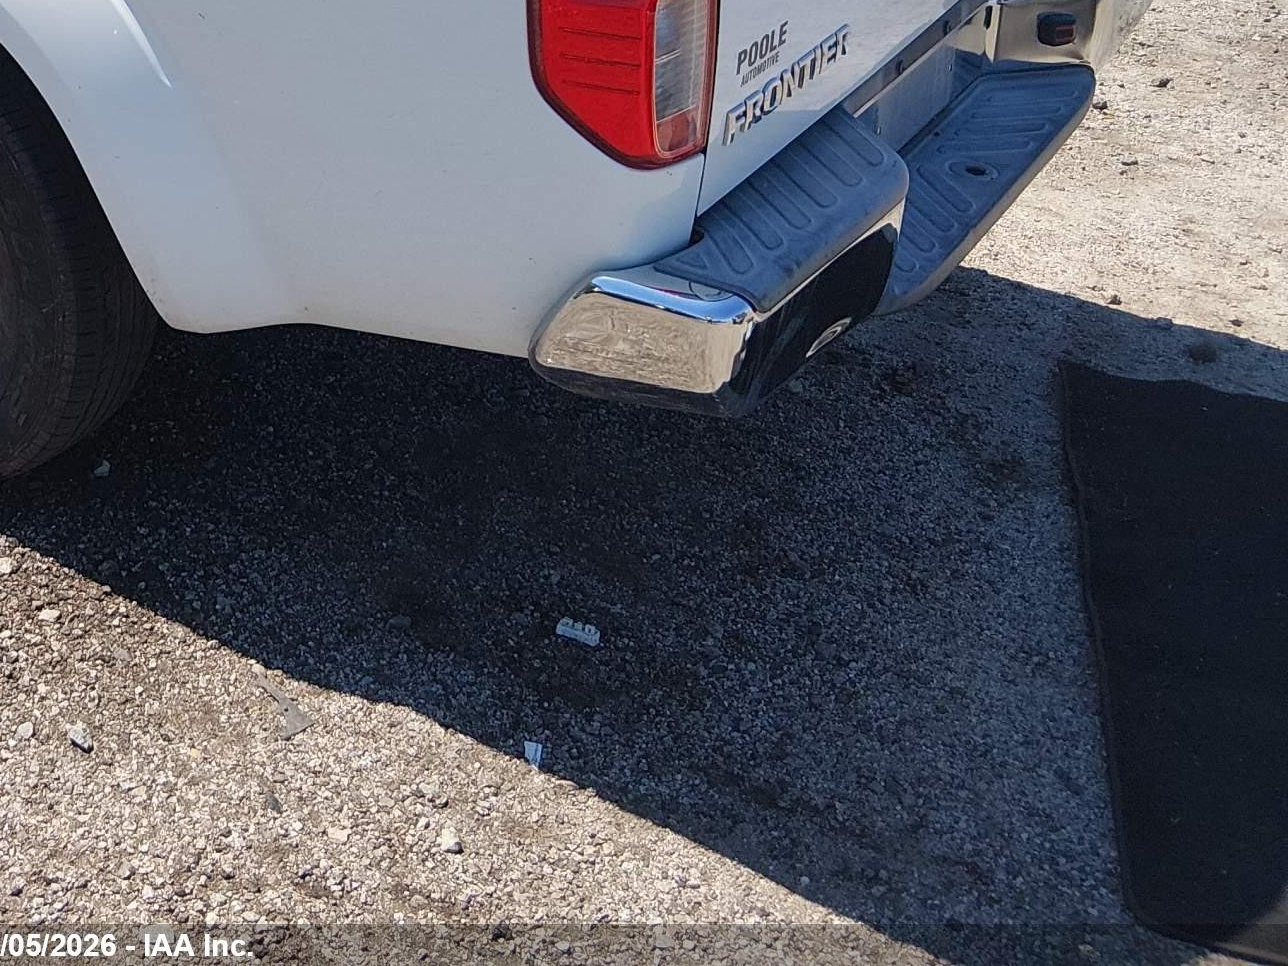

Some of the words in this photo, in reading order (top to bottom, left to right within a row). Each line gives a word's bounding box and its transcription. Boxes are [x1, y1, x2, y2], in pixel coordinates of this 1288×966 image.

[735, 20, 789, 76] POOLE
[740, 50, 781, 87] AUTOMOTIVE
[722, 23, 850, 147] FRONTIER
